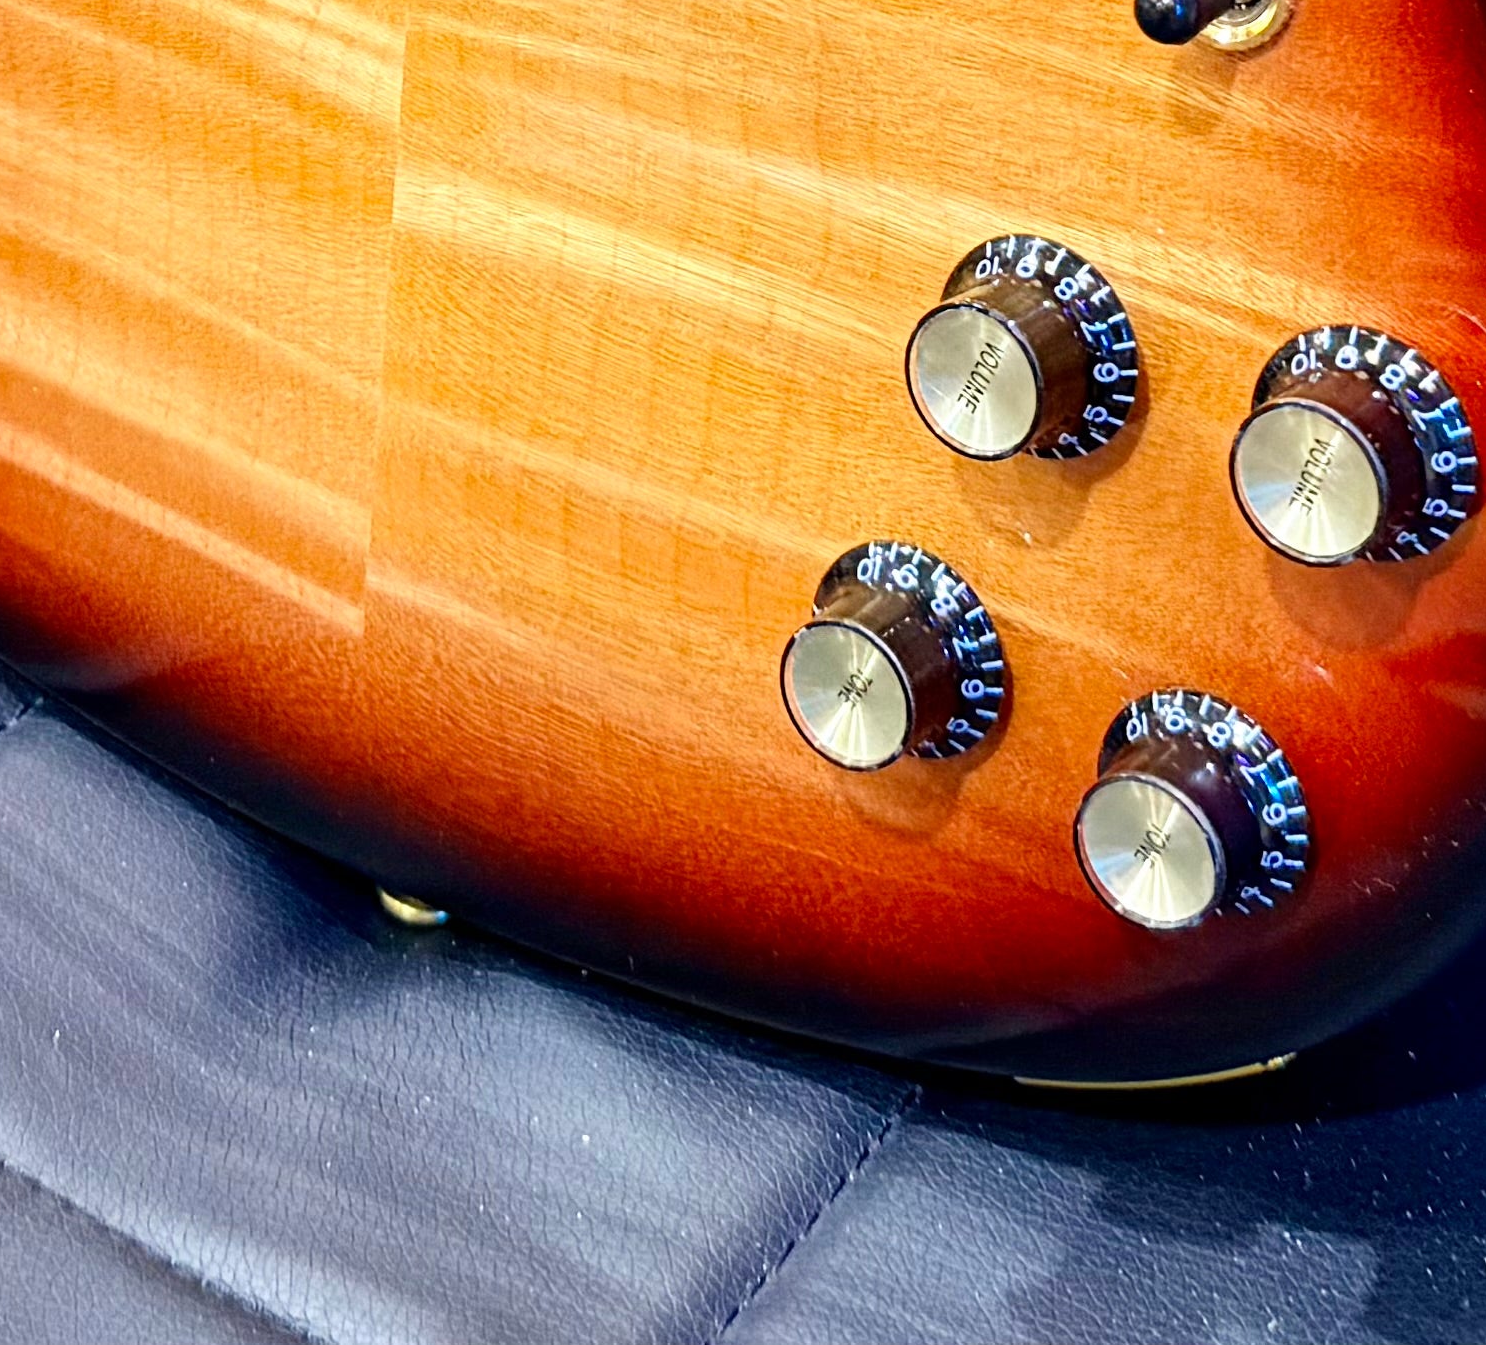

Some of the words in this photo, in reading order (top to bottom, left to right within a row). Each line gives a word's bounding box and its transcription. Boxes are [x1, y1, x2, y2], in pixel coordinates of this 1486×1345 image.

[956, 341, 1005, 415] VOLUME
[1054, 277, 1079, 301] 8
[1082, 404, 1108, 423] 5
[1288, 437, 1333, 516] VOLUME
[1379, 363, 1407, 392] 8
[1421, 497, 1449, 517] 5
[930, 591, 961, 617] 8
[837, 668, 874, 708] TONE
[1207, 720, 1233, 749] 8
[1260, 851, 1284, 869] 5
[1133, 822, 1172, 869] TONE
